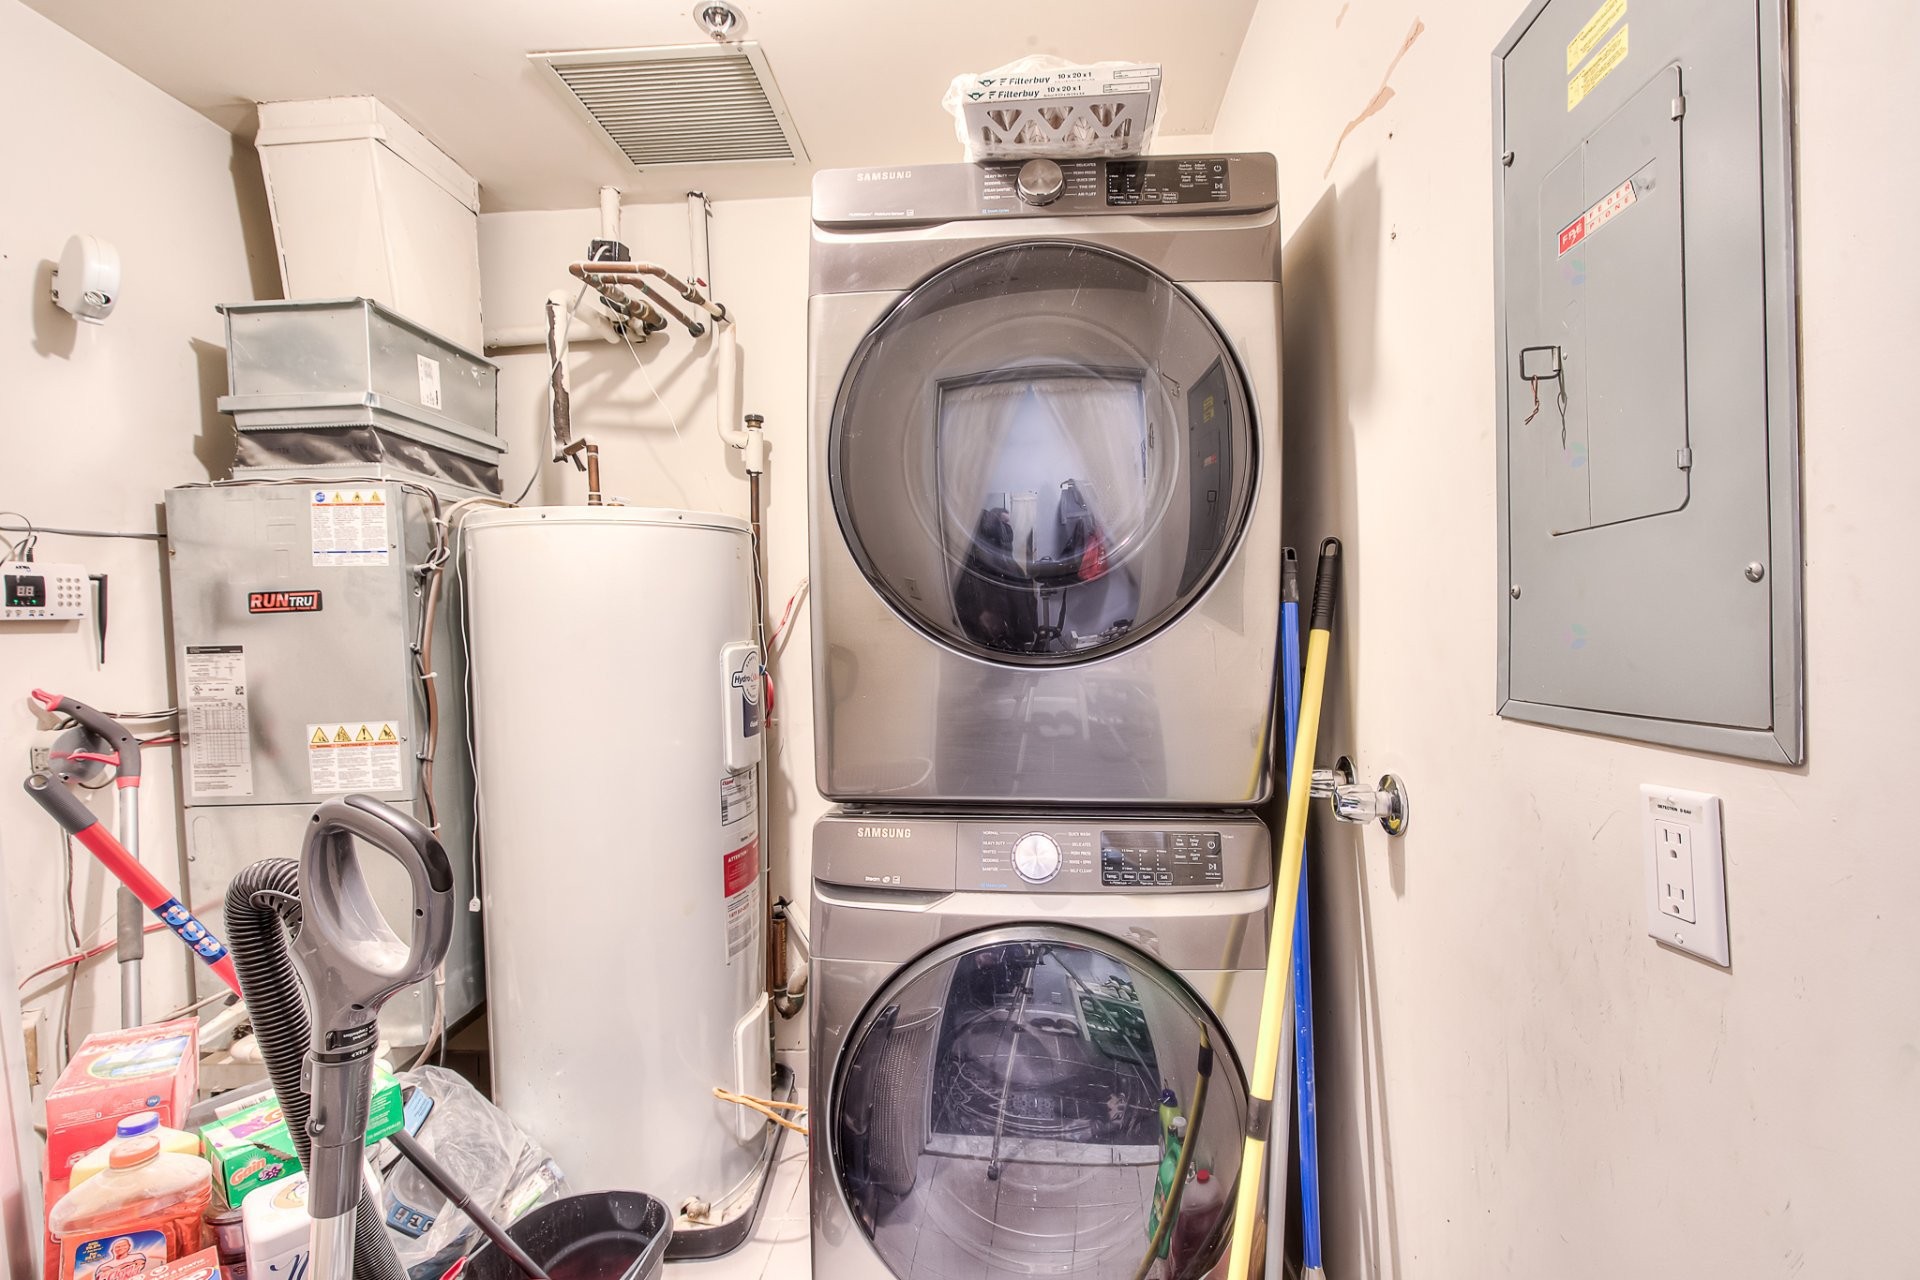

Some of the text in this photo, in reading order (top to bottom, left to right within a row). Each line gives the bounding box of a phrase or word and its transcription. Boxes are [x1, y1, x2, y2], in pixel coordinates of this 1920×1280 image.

[1008, 76, 1050, 86] Filterbuy
[998, 89, 1040, 99] Filterbuy
[856, 171, 912, 182] SAMSUNG
[250, 593, 313, 608] RUNTRU
[857, 827, 911, 838] SAMSUNG
[230, 1157, 267, 1186] Gain
